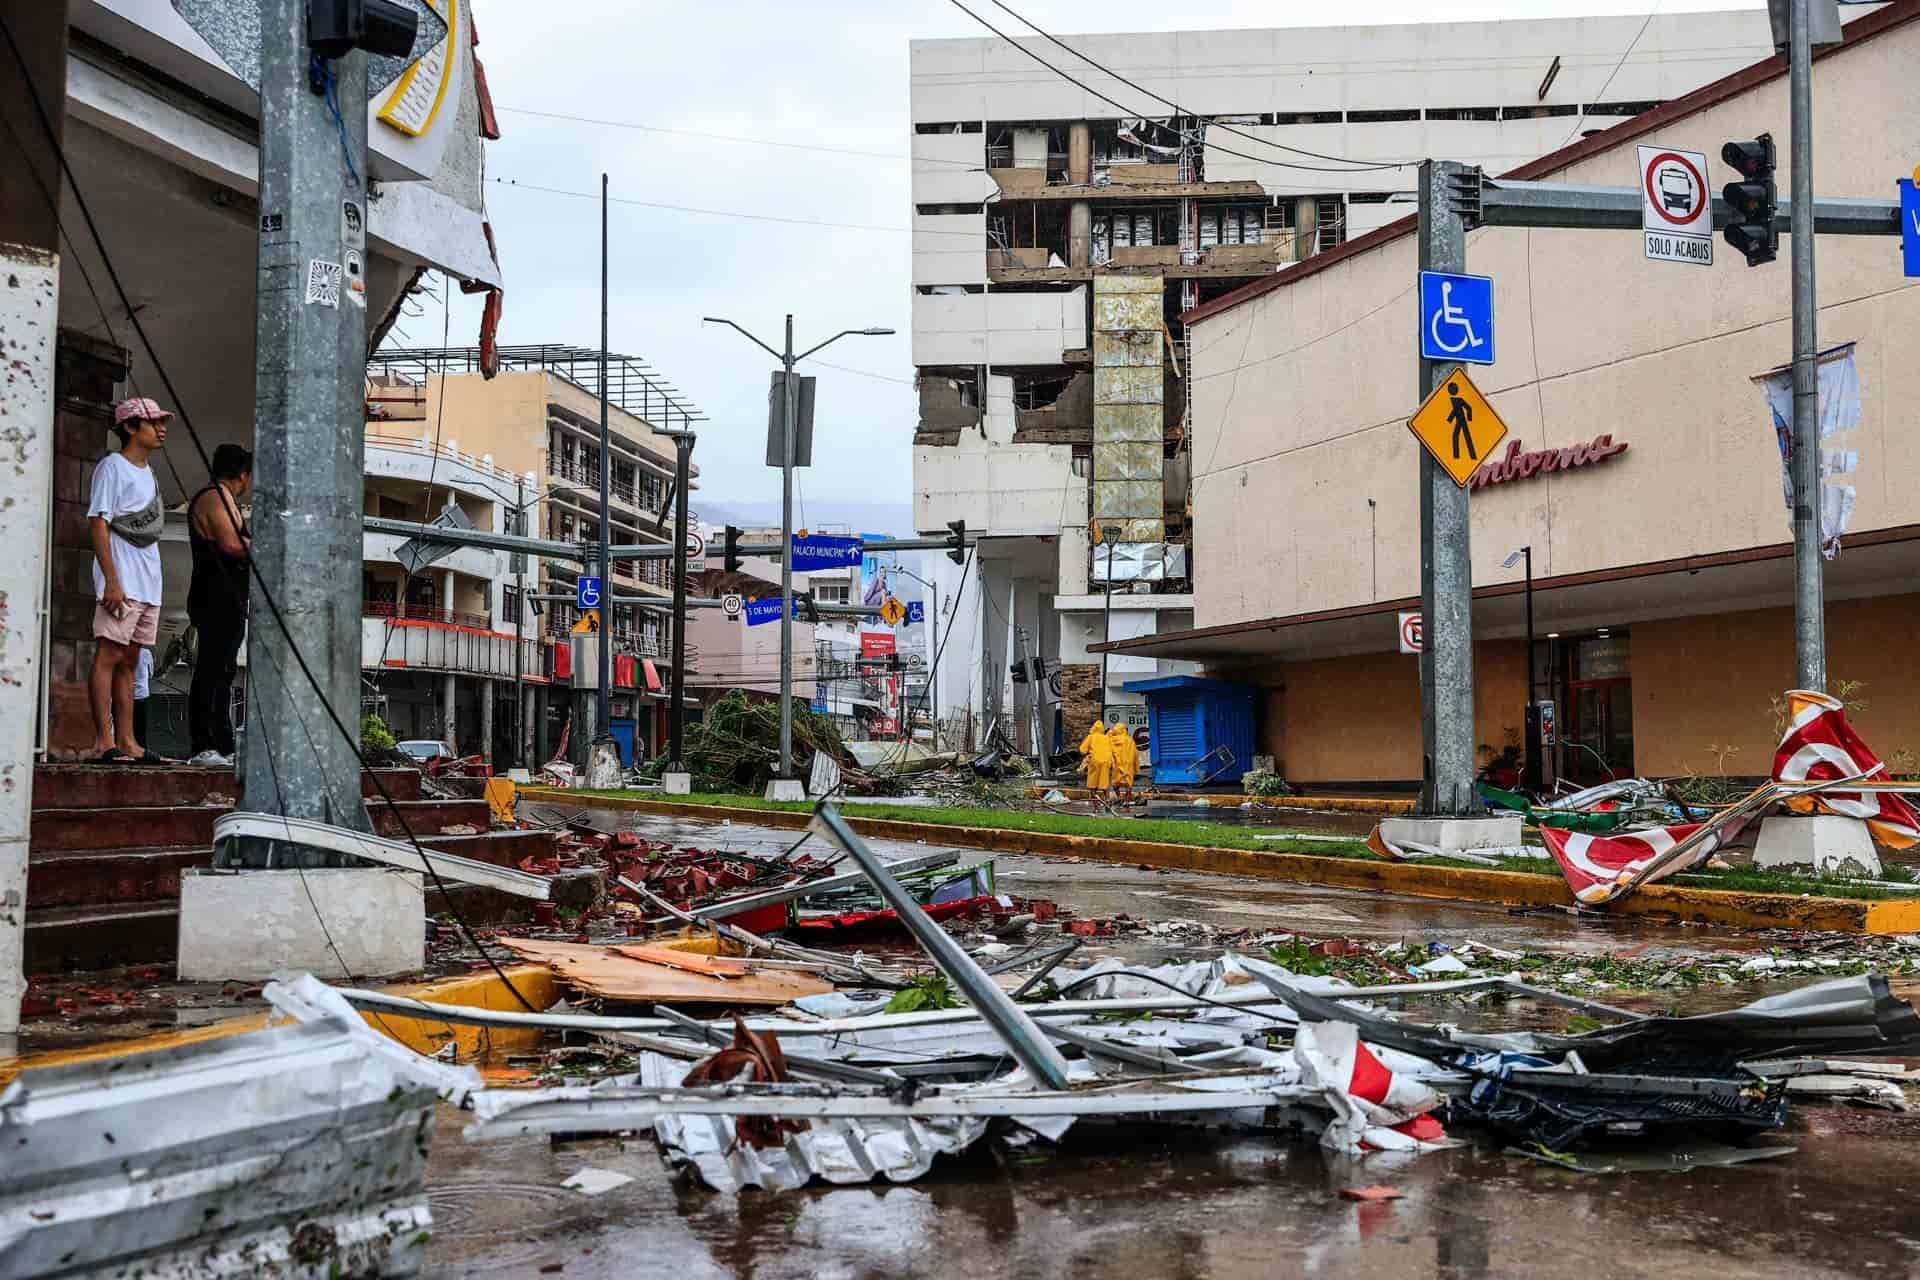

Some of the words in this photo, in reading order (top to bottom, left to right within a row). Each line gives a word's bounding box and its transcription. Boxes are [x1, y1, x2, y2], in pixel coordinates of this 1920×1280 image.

[1648, 237, 1671, 256] SOLO
[1675, 240, 1709, 260] ACABUS
[1469, 433, 1629, 489] nborns
[792, 544, 816, 558] PALACIO
[727, 599, 737, 609] 40
[753, 607, 763, 616] DE
[763, 606, 782, 615] MAYO
